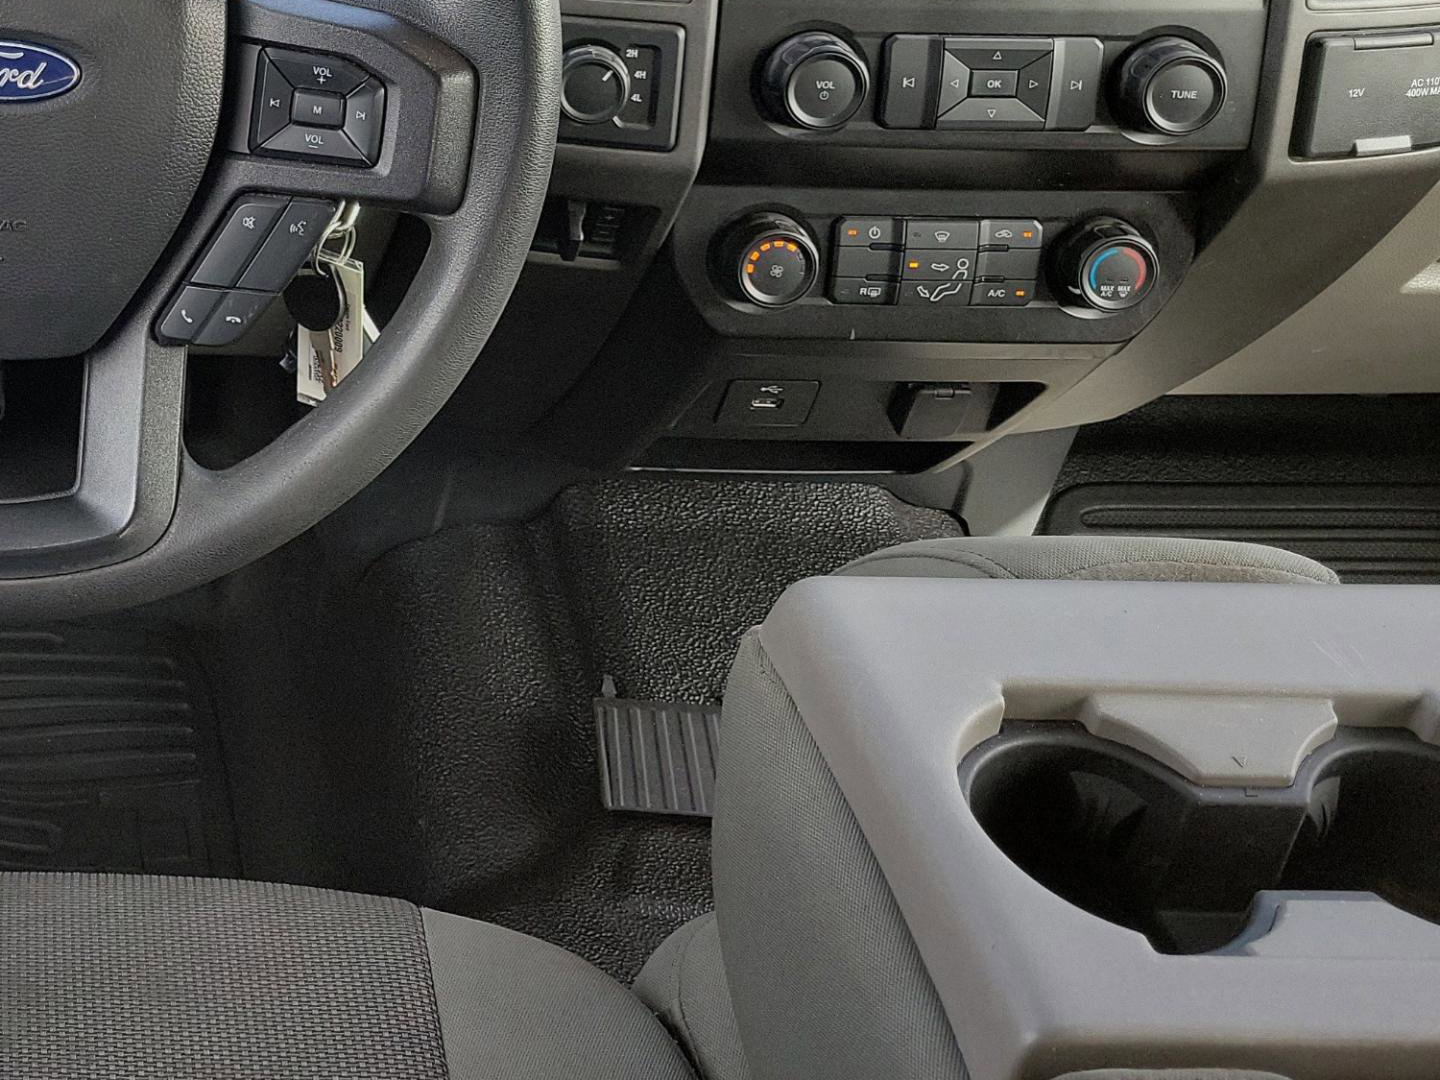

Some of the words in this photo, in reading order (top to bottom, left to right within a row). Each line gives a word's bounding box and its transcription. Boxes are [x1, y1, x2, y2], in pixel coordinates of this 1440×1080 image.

[312, 65, 334, 78] VOL
[816, 80, 835, 90] VOL
[986, 79, 1003, 89] OK
[1411, 78, 1425, 88] AC
[1426, 76, 1440, 86] 110
[1171, 89, 1198, 99] TUNE
[1348, 88, 1366, 98] 12V
[312, 105, 322, 115] M
[304, 133, 324, 145] VOL
[987, 289, 1006, 298] A/C
